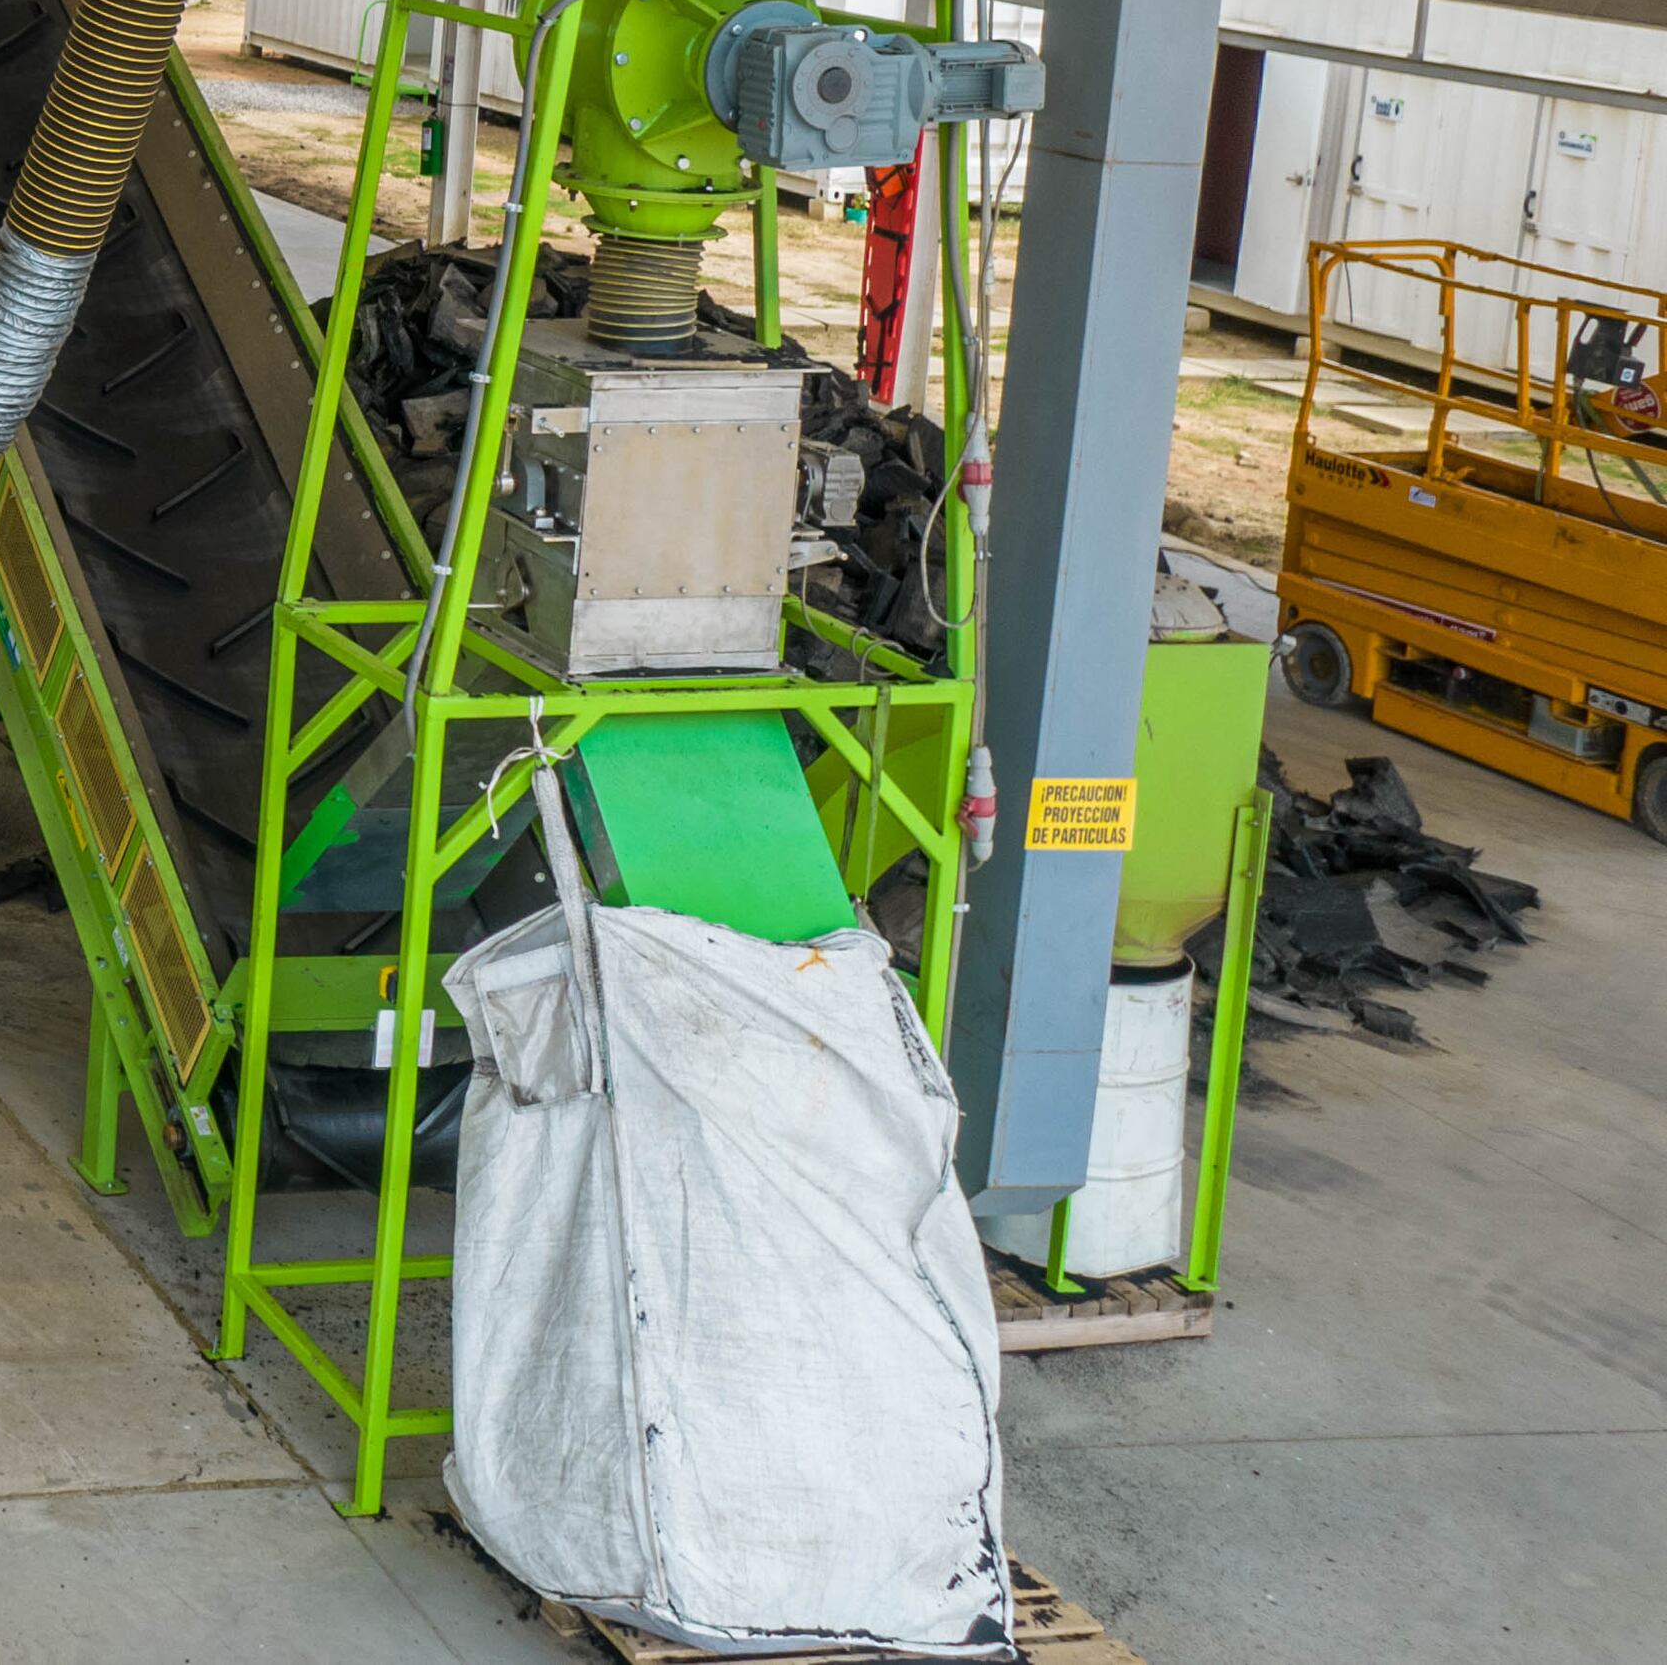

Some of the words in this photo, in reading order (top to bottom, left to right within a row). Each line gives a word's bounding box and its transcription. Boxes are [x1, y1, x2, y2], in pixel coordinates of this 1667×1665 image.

[1305, 448, 1367, 481] Haulotte
[1043, 806, 1121, 823] PROYECCION
[1032, 827, 1048, 844] DE
[1051, 827, 1126, 844] PARTICULAS
